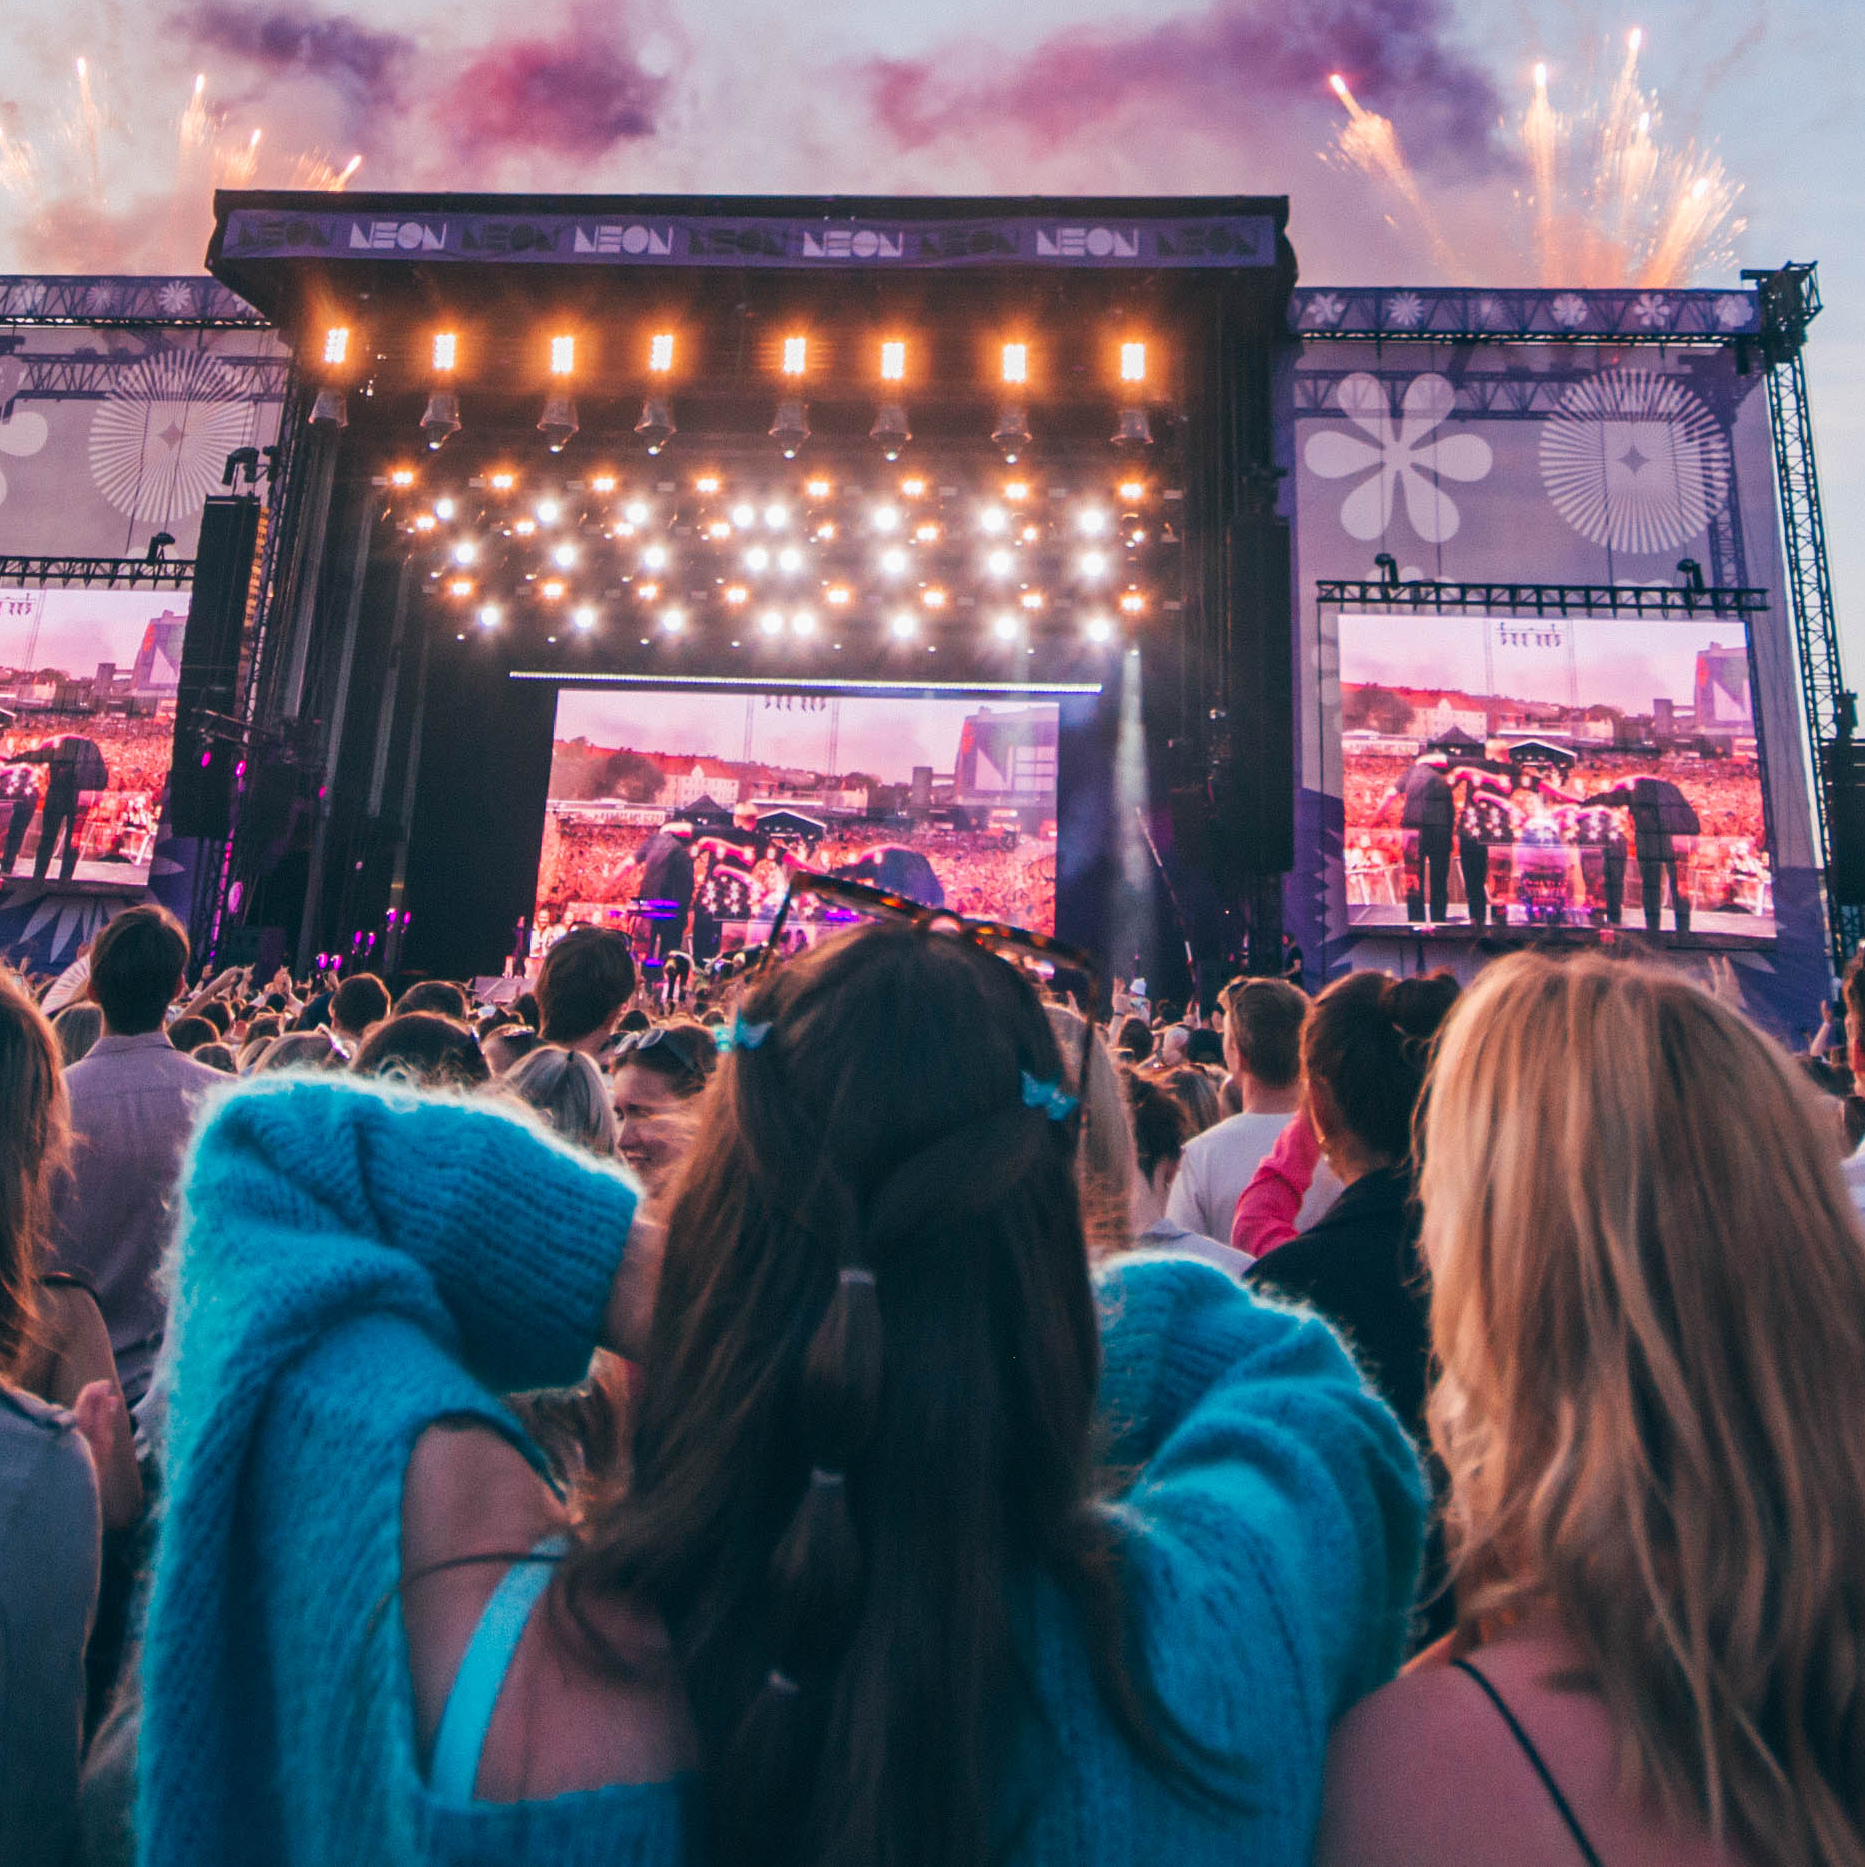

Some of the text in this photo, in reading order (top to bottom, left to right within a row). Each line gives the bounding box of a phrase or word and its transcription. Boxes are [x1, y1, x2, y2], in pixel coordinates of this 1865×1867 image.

[238, 220, 1257, 257] NEON NEON NEON NEON NEON NEON NEON NEON NEON
